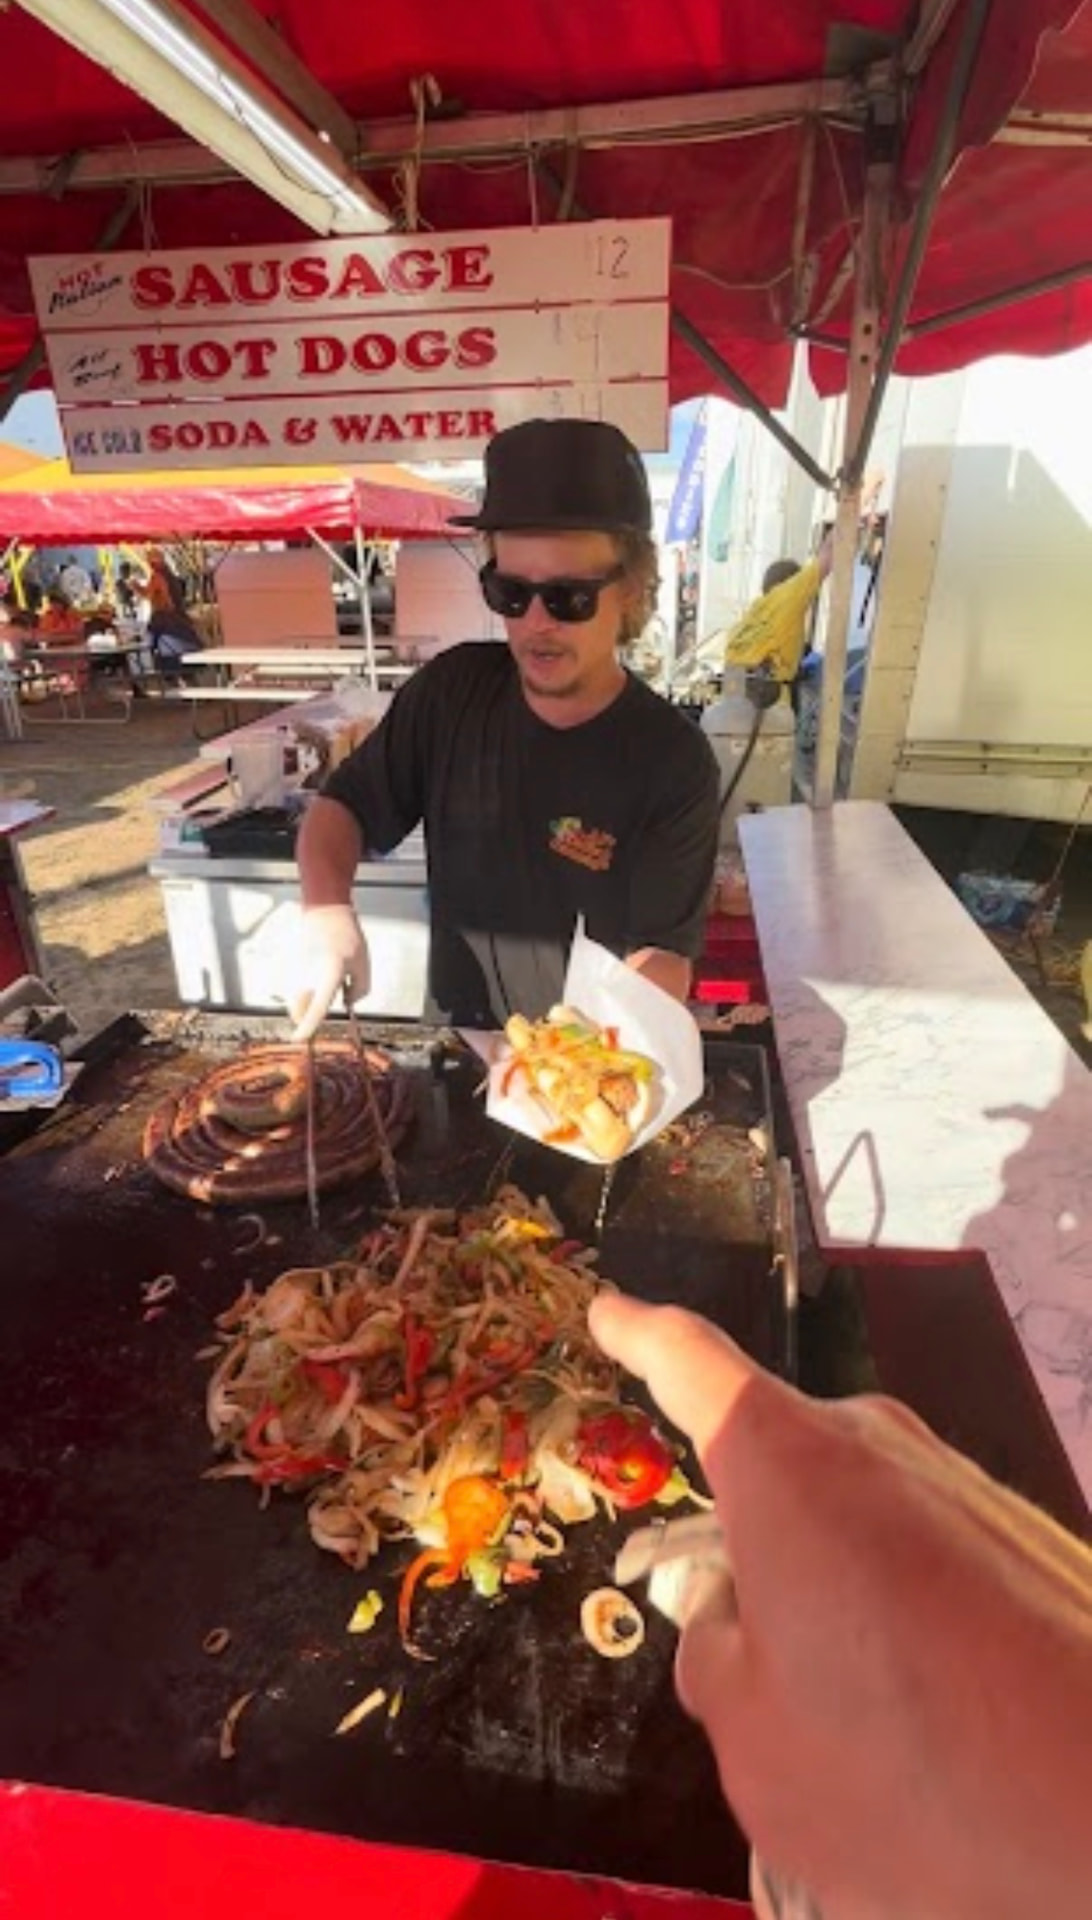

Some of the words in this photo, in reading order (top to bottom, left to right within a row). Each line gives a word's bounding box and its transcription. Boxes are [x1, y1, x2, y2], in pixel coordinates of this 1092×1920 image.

[59, 262, 103, 290] HOT
[131, 245, 494, 310] SAUSAGE
[132, 338, 276, 383] HOT
[295, 327, 497, 376] DOGS
[148, 420, 269, 450] SODA
[284, 418, 316, 446] &
[330, 410, 498, 444] WATER
